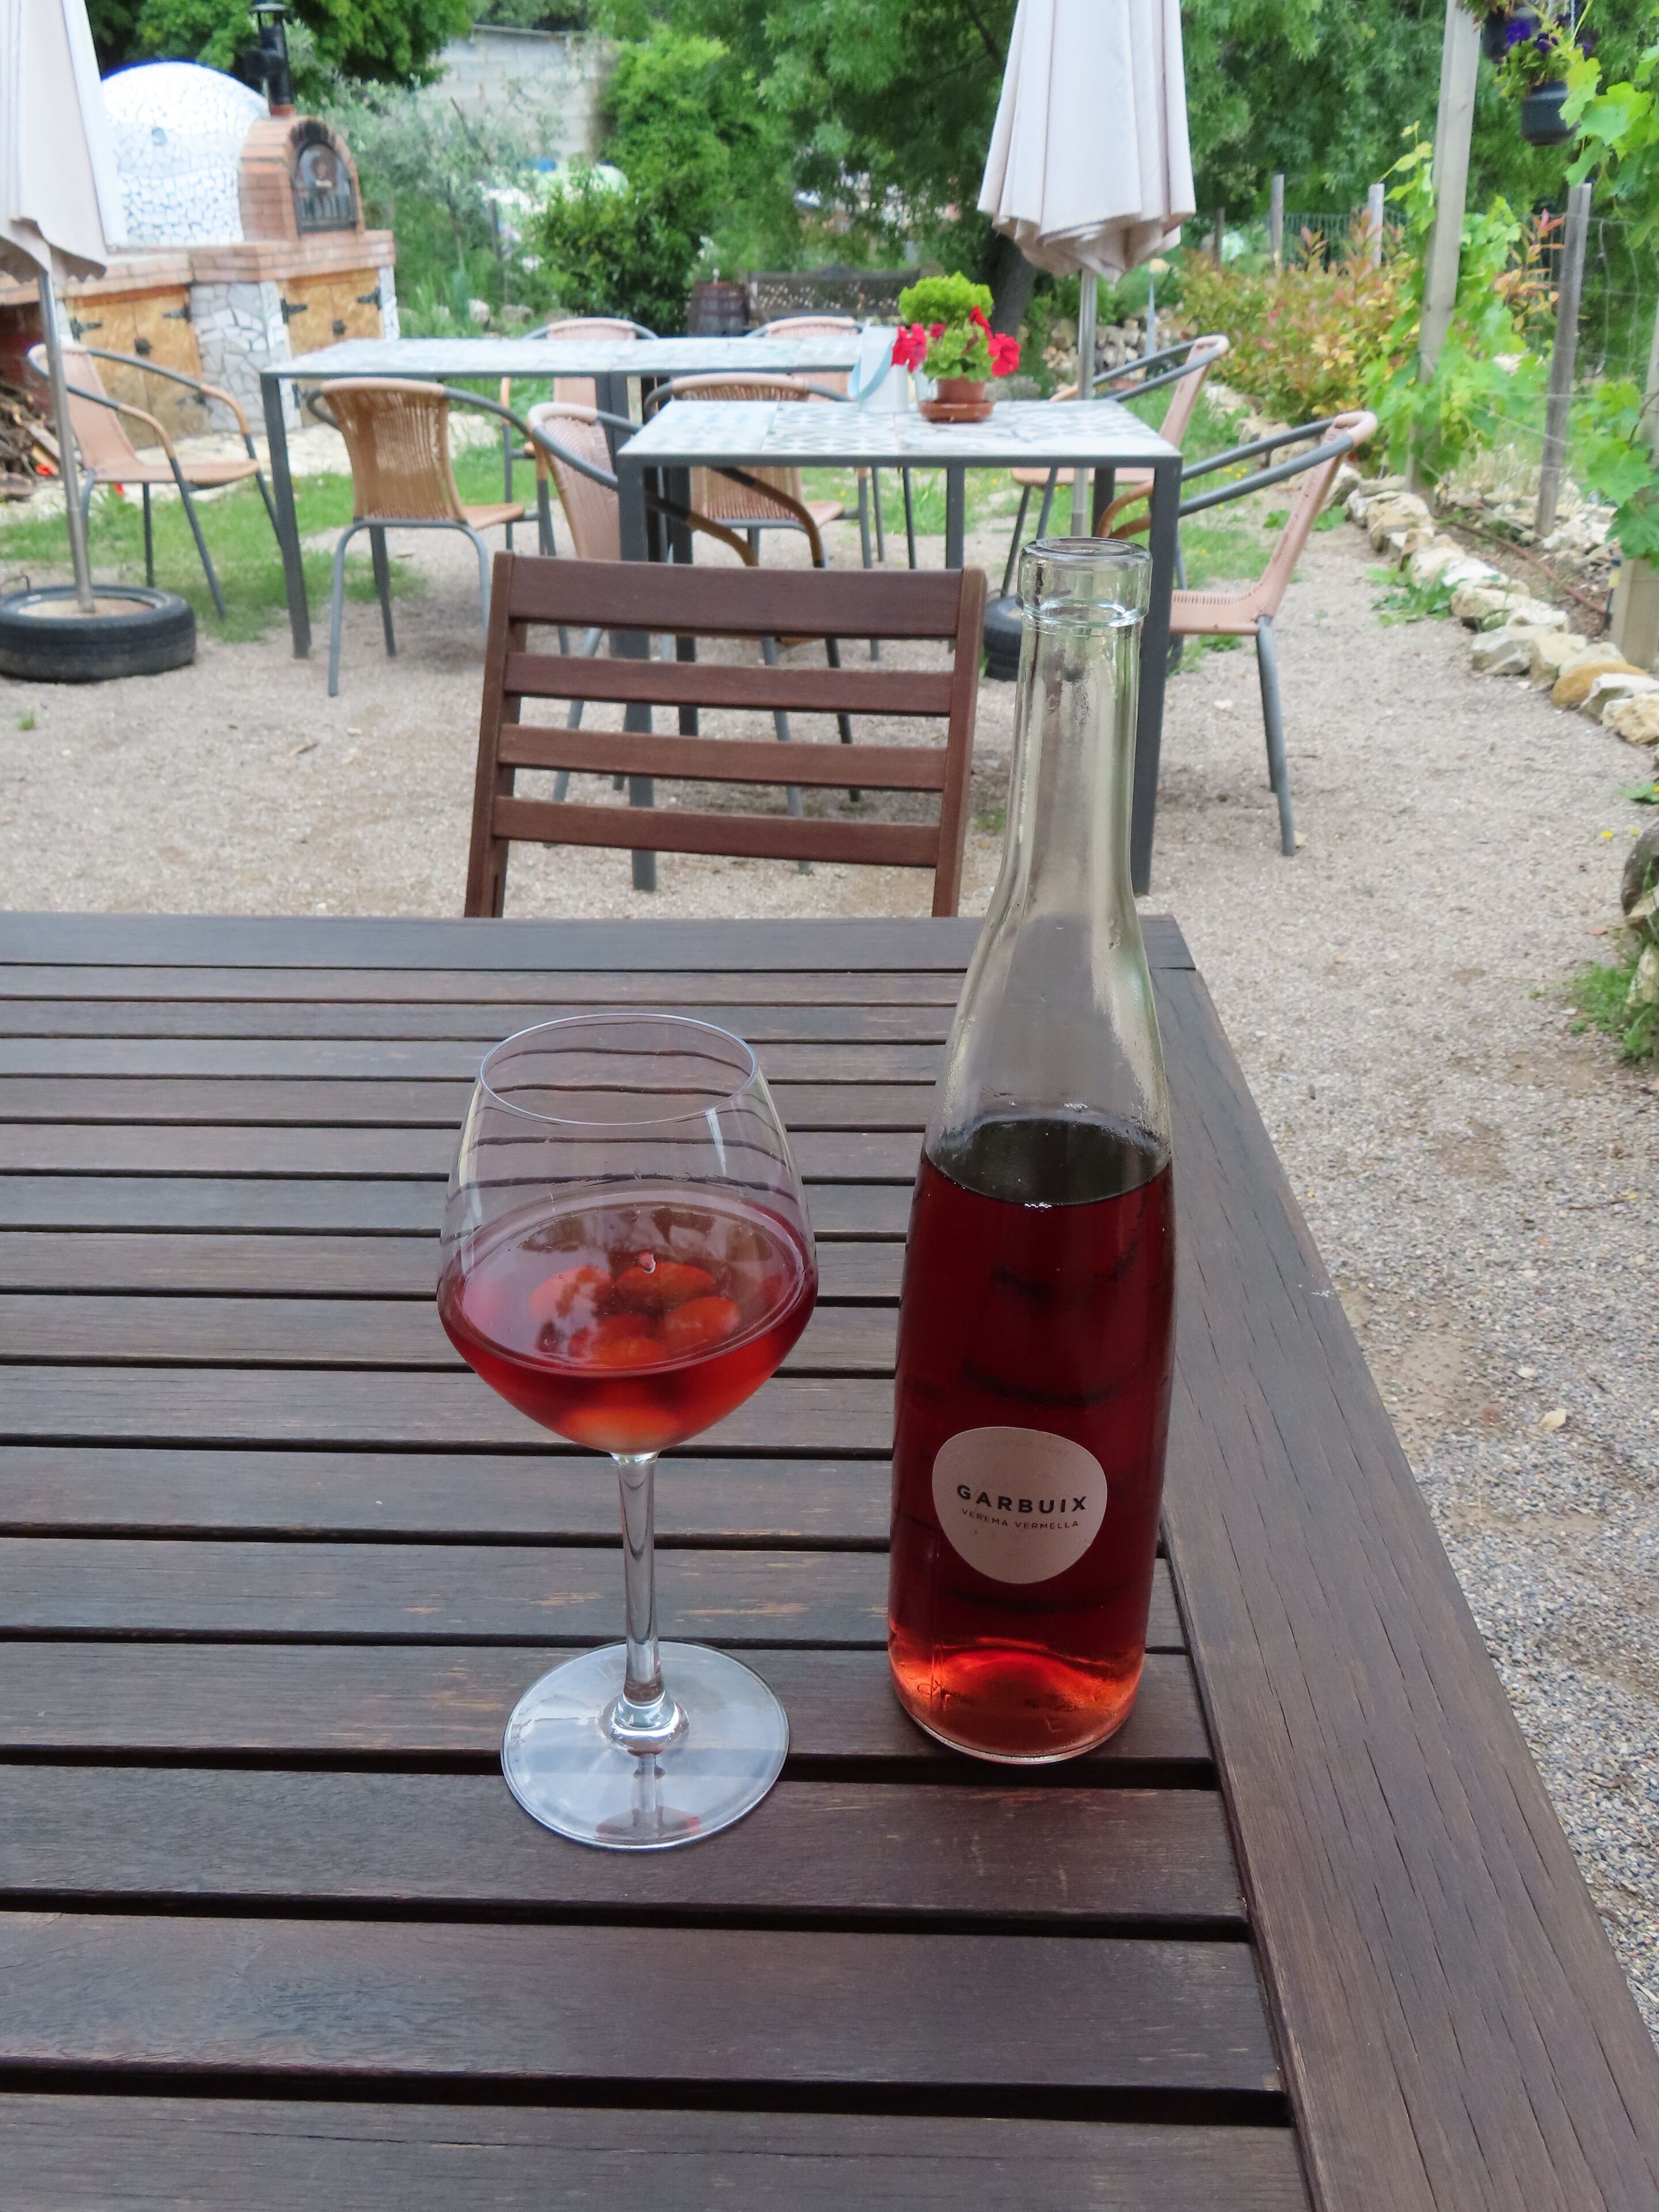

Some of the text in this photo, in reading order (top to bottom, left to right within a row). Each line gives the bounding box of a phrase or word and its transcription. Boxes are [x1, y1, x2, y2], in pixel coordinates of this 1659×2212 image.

[957, 1484, 1086, 1514] GARBUIX
[962, 1508, 1078, 1529] VEREMA VERMELLA
